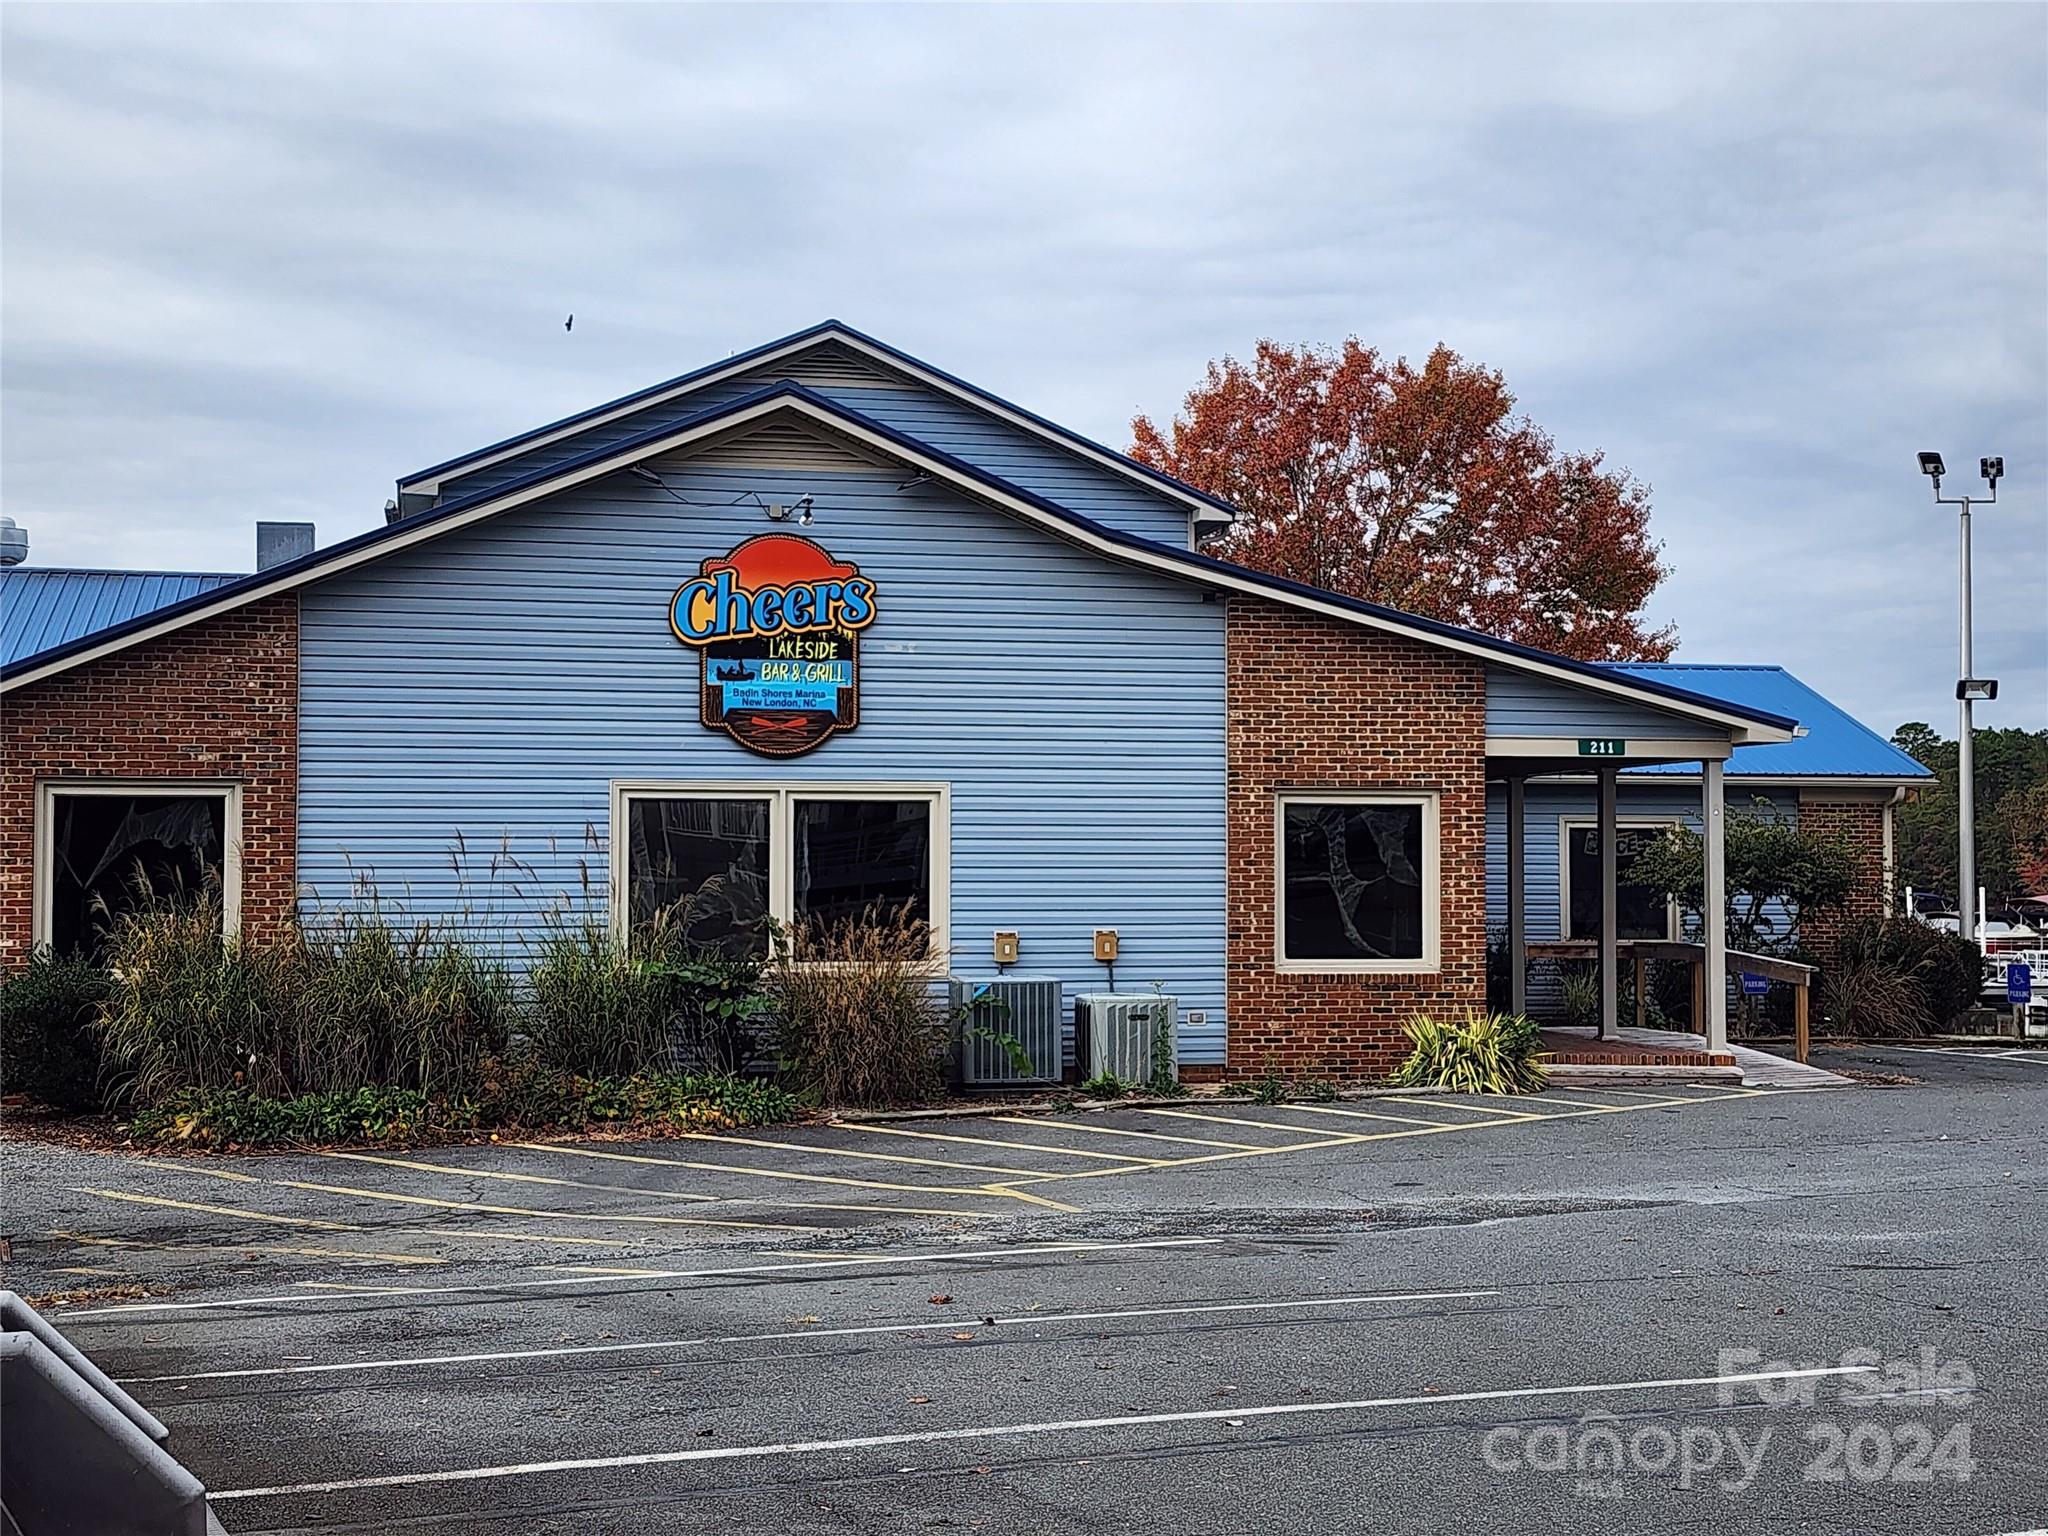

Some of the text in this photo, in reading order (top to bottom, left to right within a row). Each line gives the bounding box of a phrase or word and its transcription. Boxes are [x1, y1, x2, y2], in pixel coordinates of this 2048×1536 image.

[672, 570, 873, 641] Cheers
[769, 635, 839, 660] LAKESIDE
[761, 662, 847, 682] BAR & GRILL
[733, 687, 826, 699] Badin Shores Marina
[742, 698, 817, 708] New London, NC
[1590, 741, 1614, 754] 211
